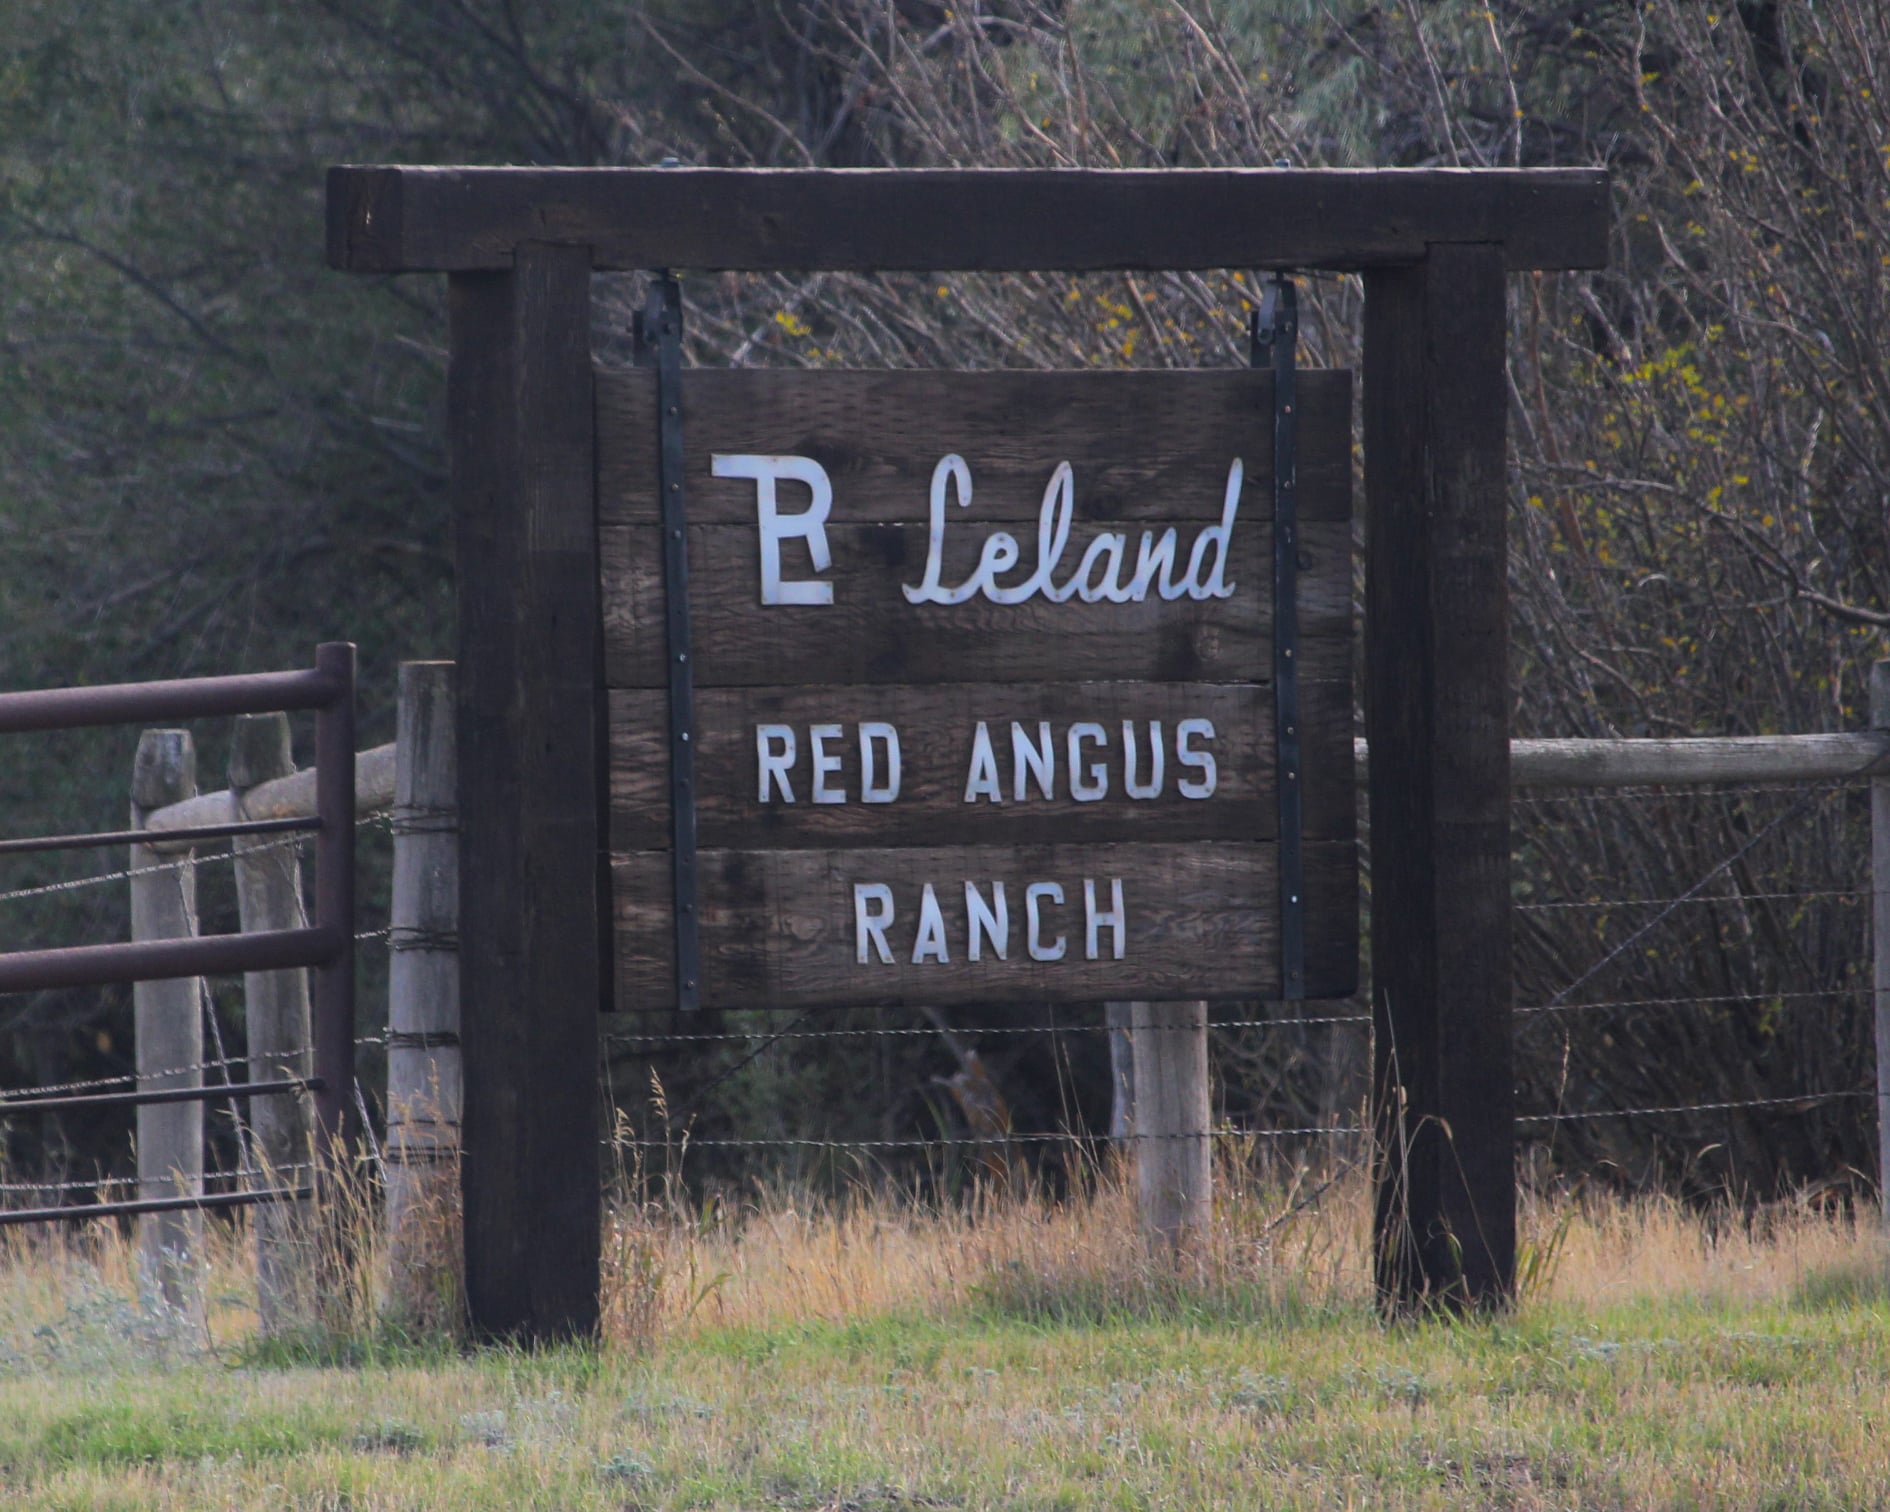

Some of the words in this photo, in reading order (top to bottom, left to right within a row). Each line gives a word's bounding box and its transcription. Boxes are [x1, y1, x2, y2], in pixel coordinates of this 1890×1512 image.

[901, 452, 1243, 605] Leland
[756, 721, 902, 805] RED
[964, 717, 1218, 804] ANGUS
[853, 878, 1127, 966] RANCH
